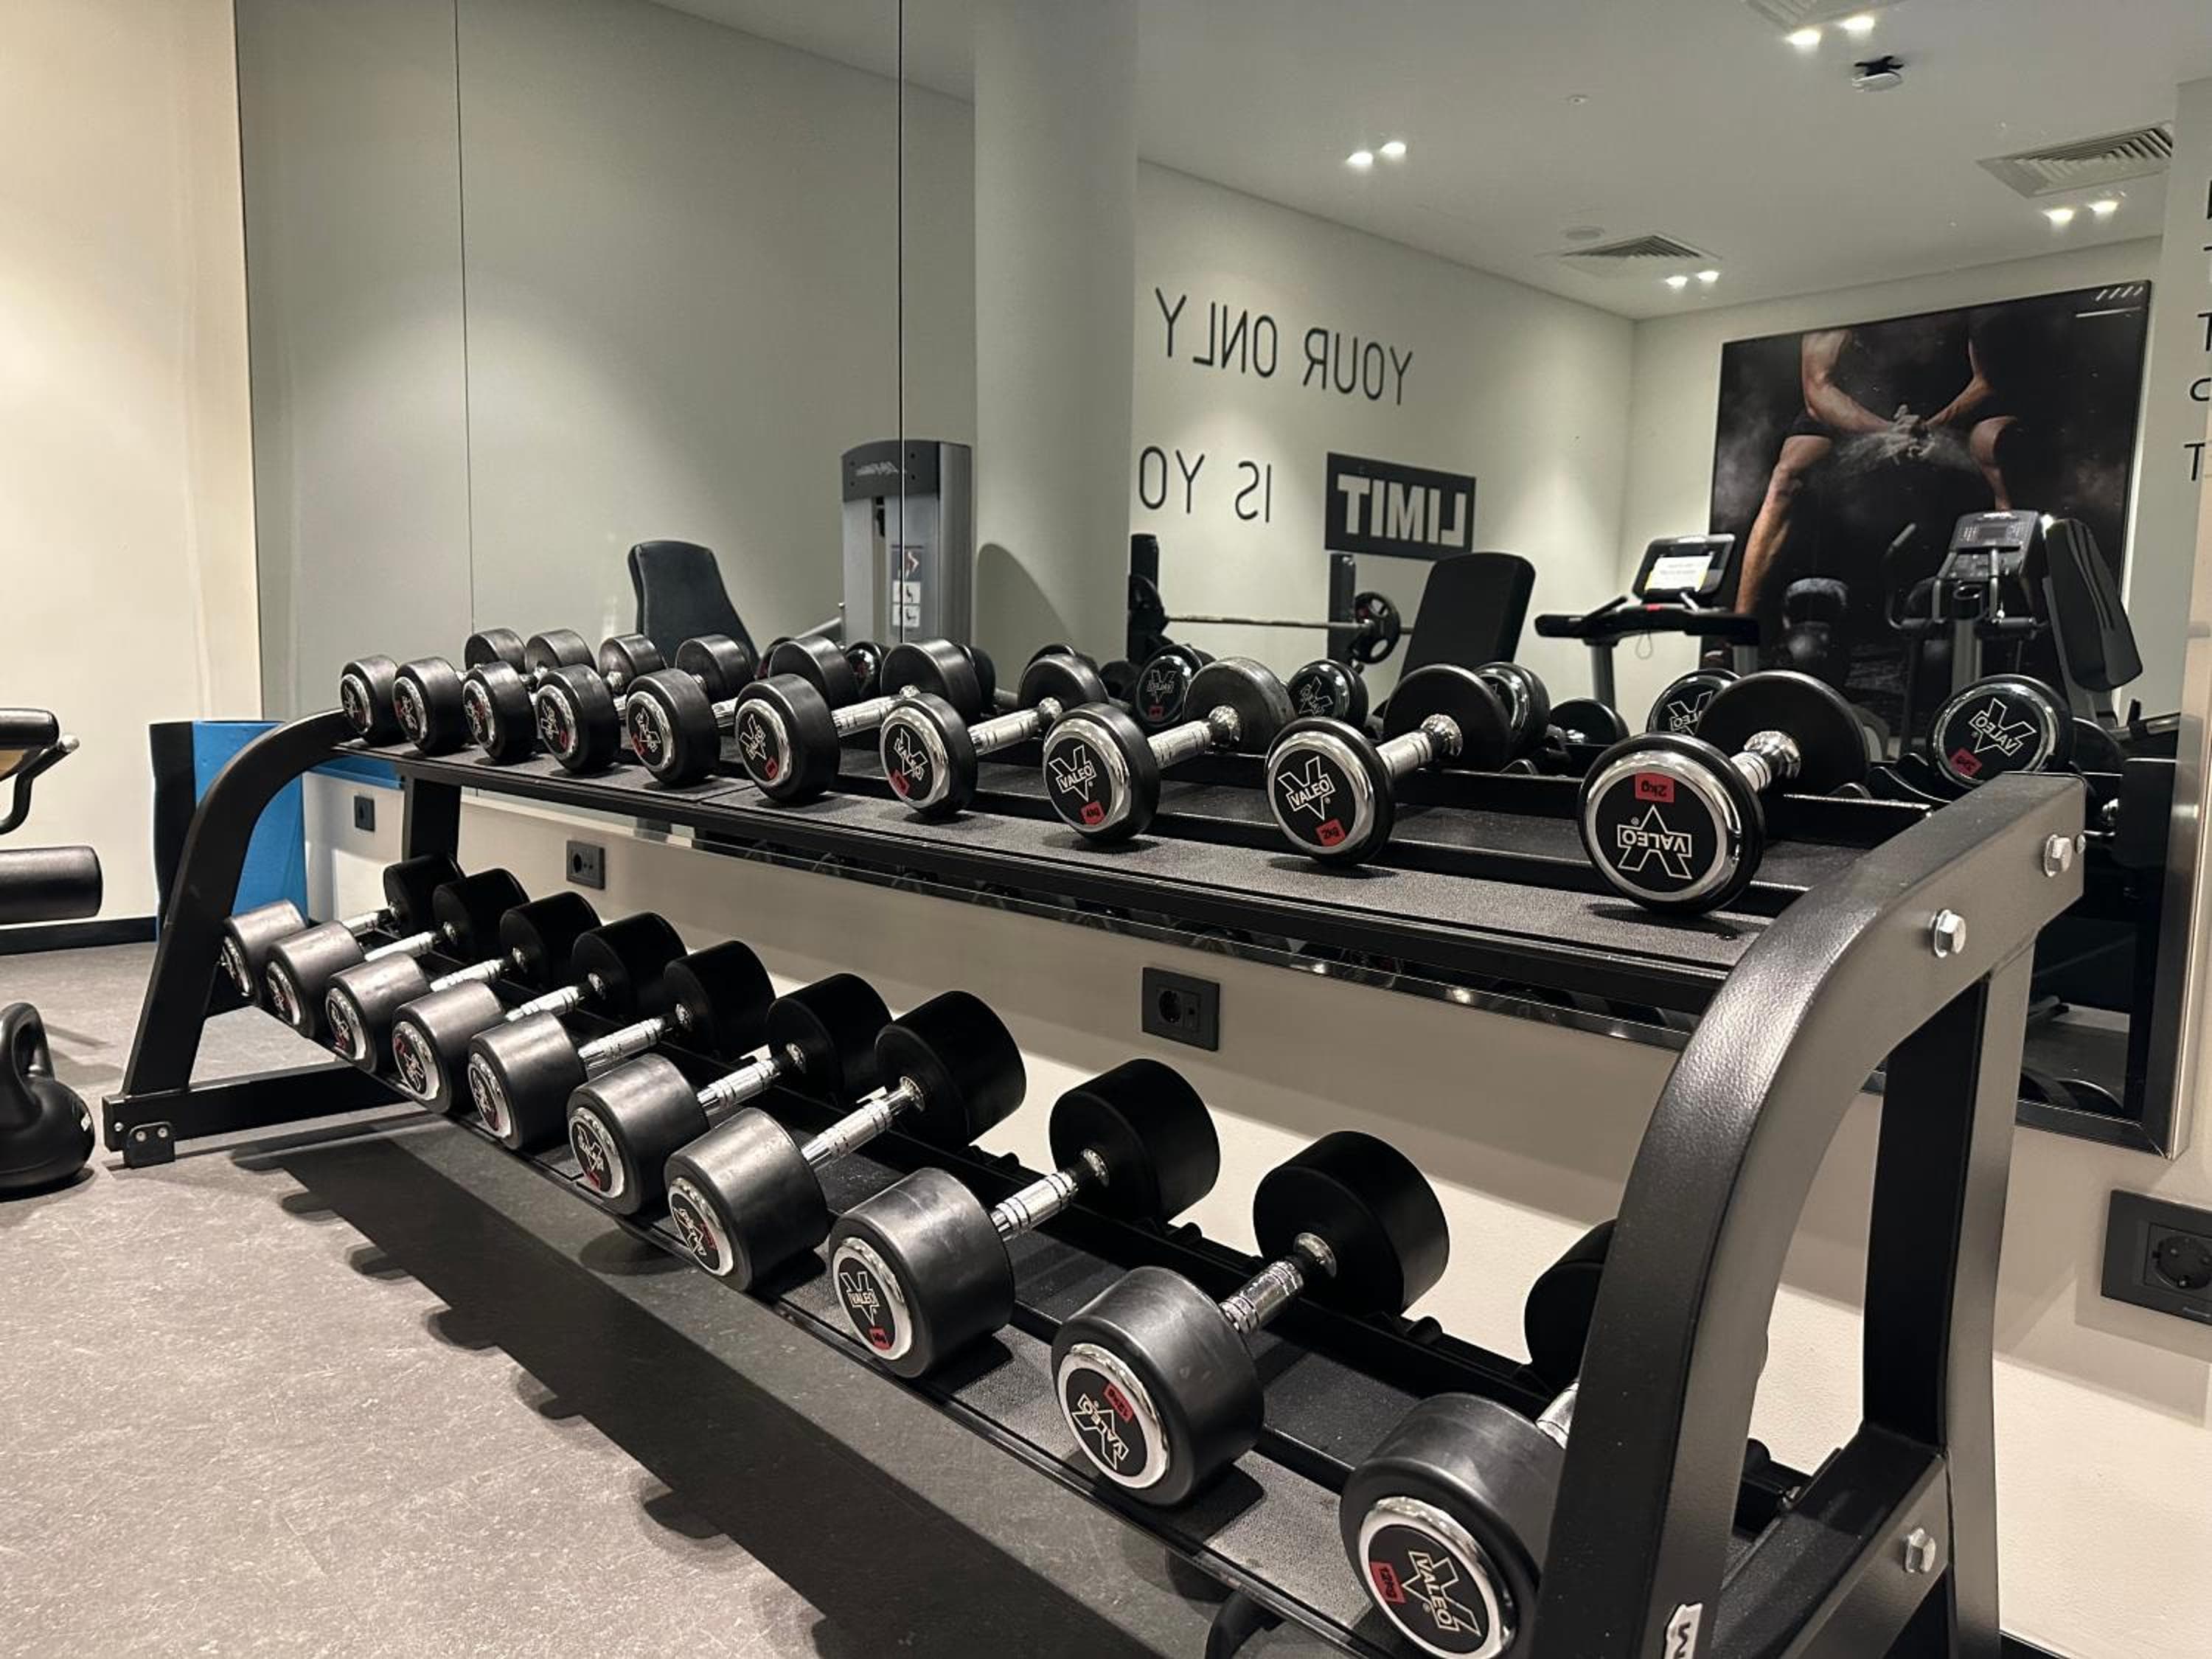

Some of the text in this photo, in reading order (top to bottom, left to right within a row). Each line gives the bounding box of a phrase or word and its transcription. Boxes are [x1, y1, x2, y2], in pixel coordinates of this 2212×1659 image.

[1060, 765, 1092, 788] VALEO
[1641, 779, 1668, 798] 2kg
[1290, 779, 1329, 805] VALEO
[1621, 829, 1687, 853] VALEO
[1082, 1400, 1122, 1455] VALEO
[1416, 1557, 1453, 1626] VALEO
